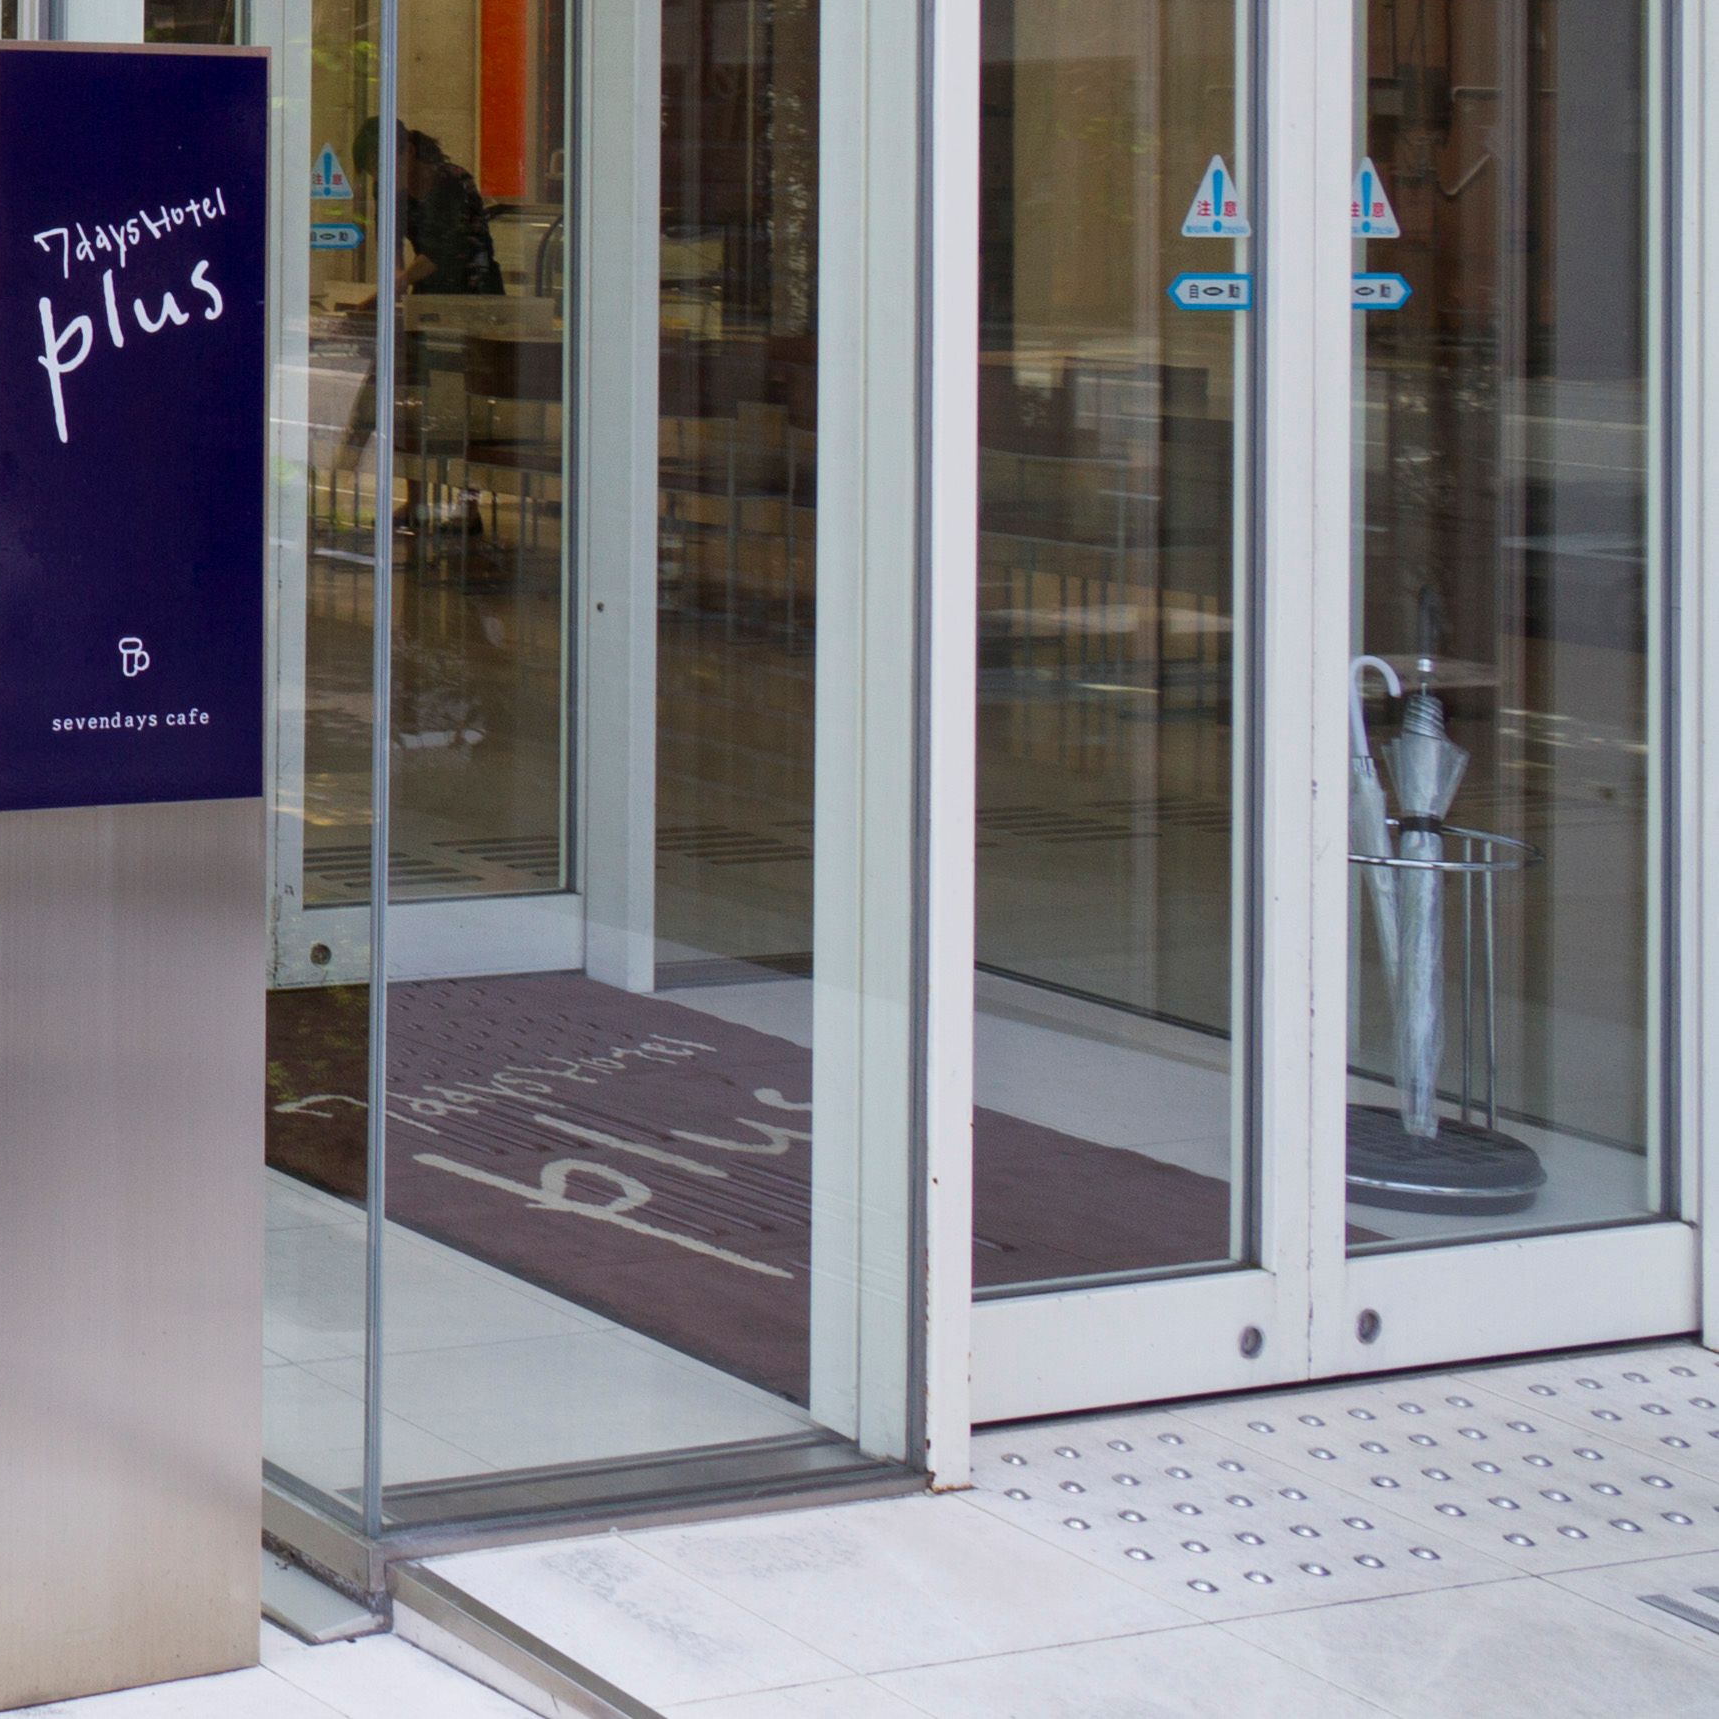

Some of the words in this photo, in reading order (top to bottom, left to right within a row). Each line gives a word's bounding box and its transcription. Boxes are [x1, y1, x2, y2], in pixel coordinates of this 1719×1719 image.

[1196, 199, 1238, 218] 注意
[36, 259, 224, 444] plus
[51, 711, 159, 732] sevendays
[165, 707, 211, 726] cafe
